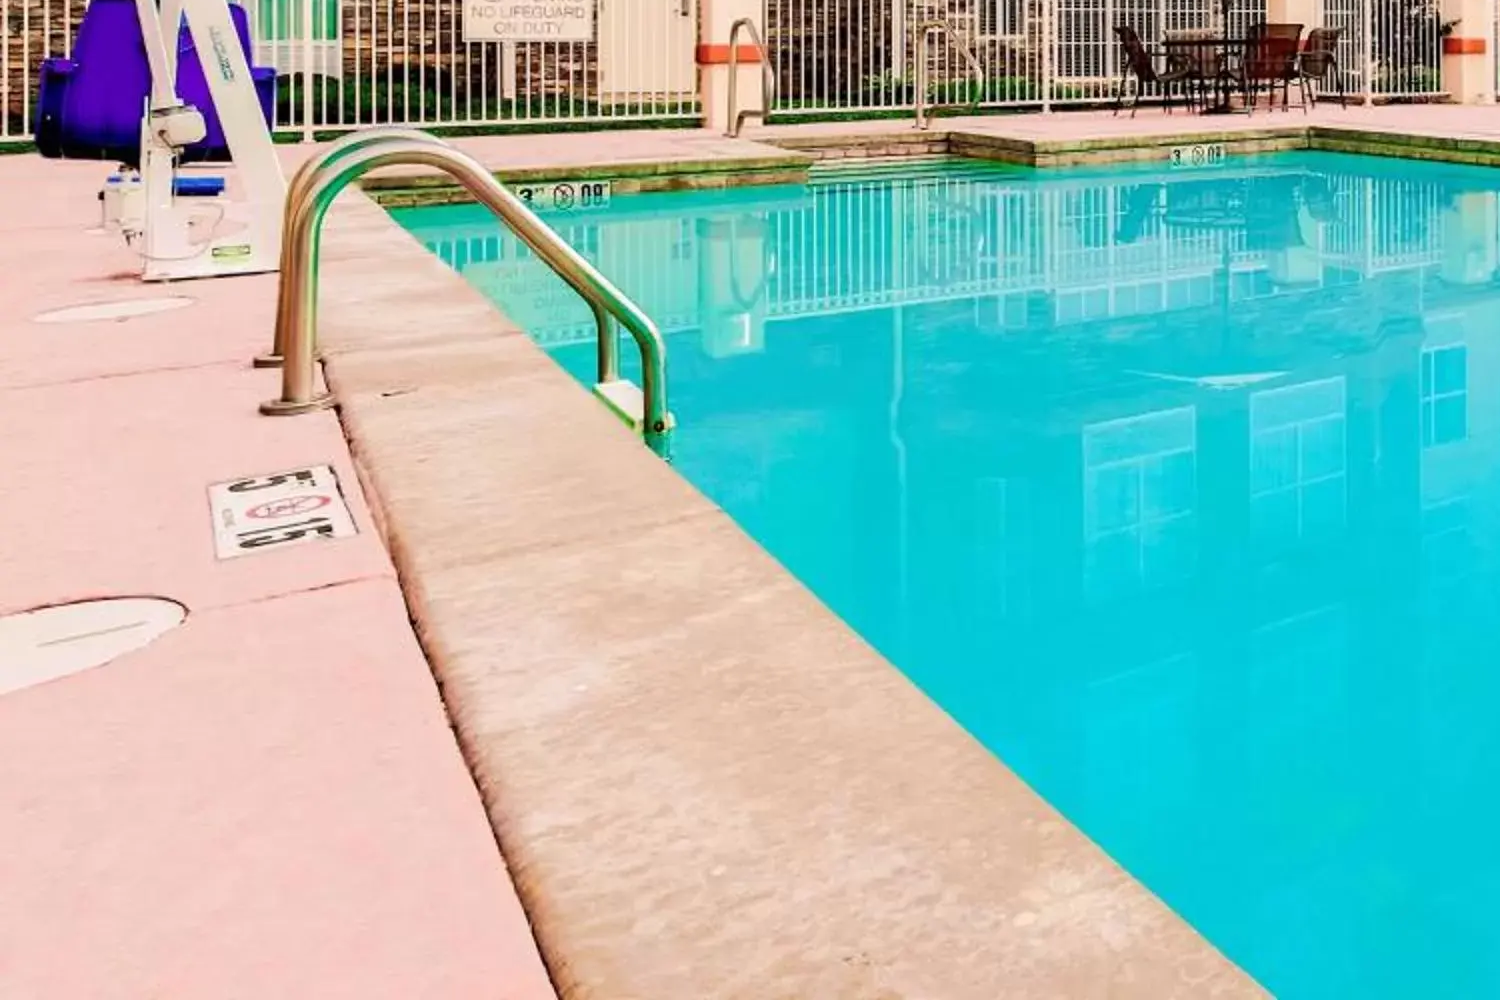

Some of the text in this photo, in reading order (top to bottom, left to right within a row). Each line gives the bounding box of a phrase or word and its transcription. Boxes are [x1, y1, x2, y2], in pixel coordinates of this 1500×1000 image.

[471, 5, 585, 19] NO LIFEGUARD
[493, 22, 562, 35] ON DUTY
